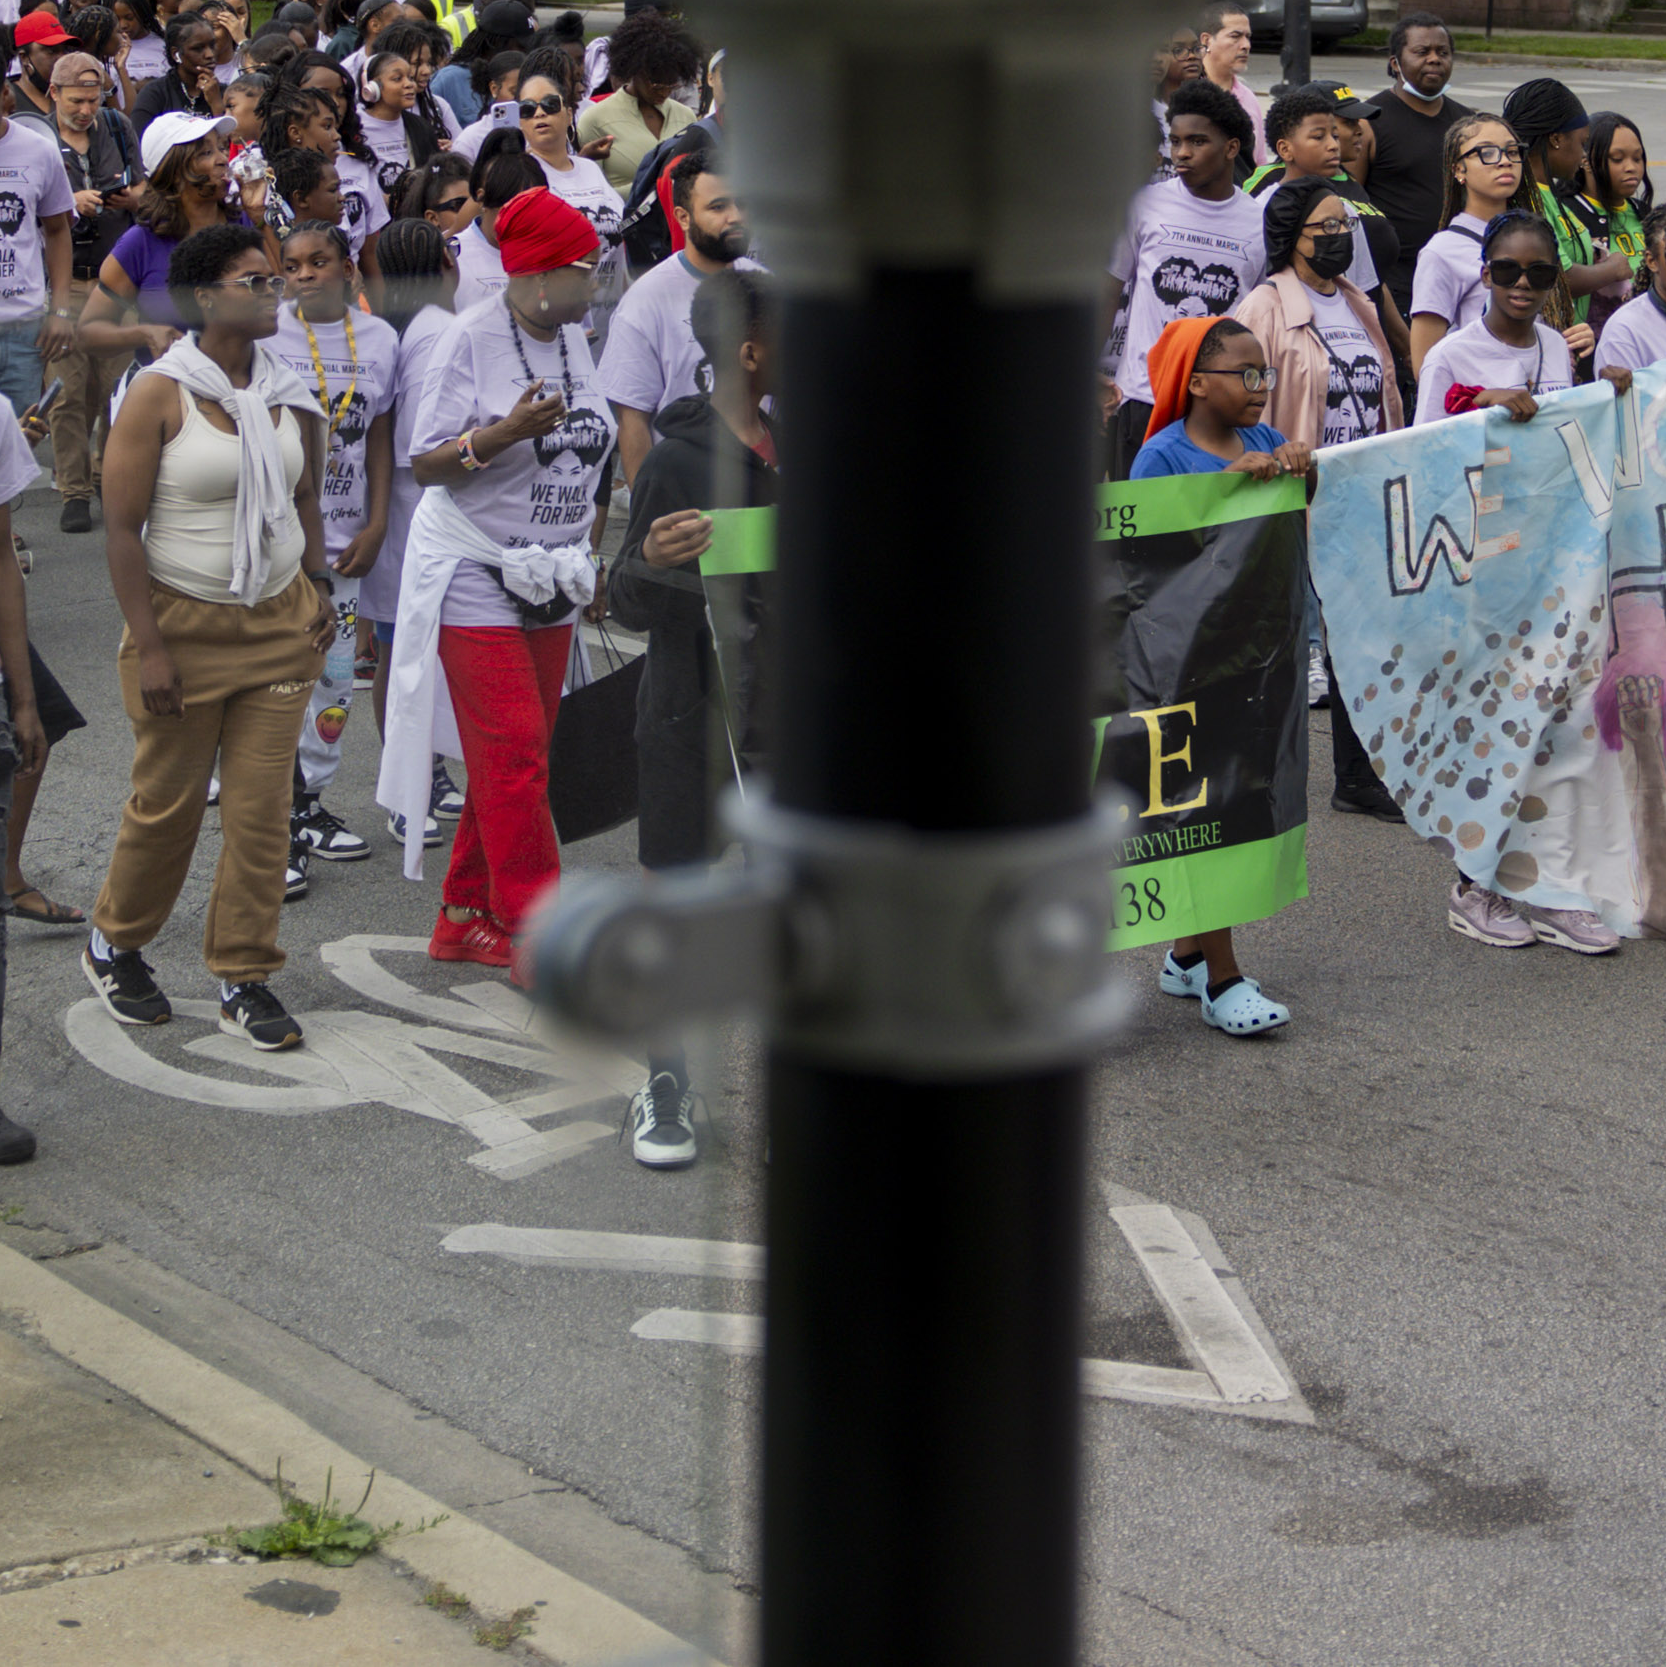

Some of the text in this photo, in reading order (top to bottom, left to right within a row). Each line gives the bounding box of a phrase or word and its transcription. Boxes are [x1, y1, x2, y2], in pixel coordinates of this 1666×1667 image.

[1172, 231, 1240, 252] 7TH ANNUAL MARCH
[295, 363, 309, 371] 7TH
[1323, 427, 1346, 444] WE
[323, 480, 352, 496] HER
[531, 484, 555, 504] WE
[531, 505, 586, 524] FOR HER
[1383, 446, 1521, 598] WE
